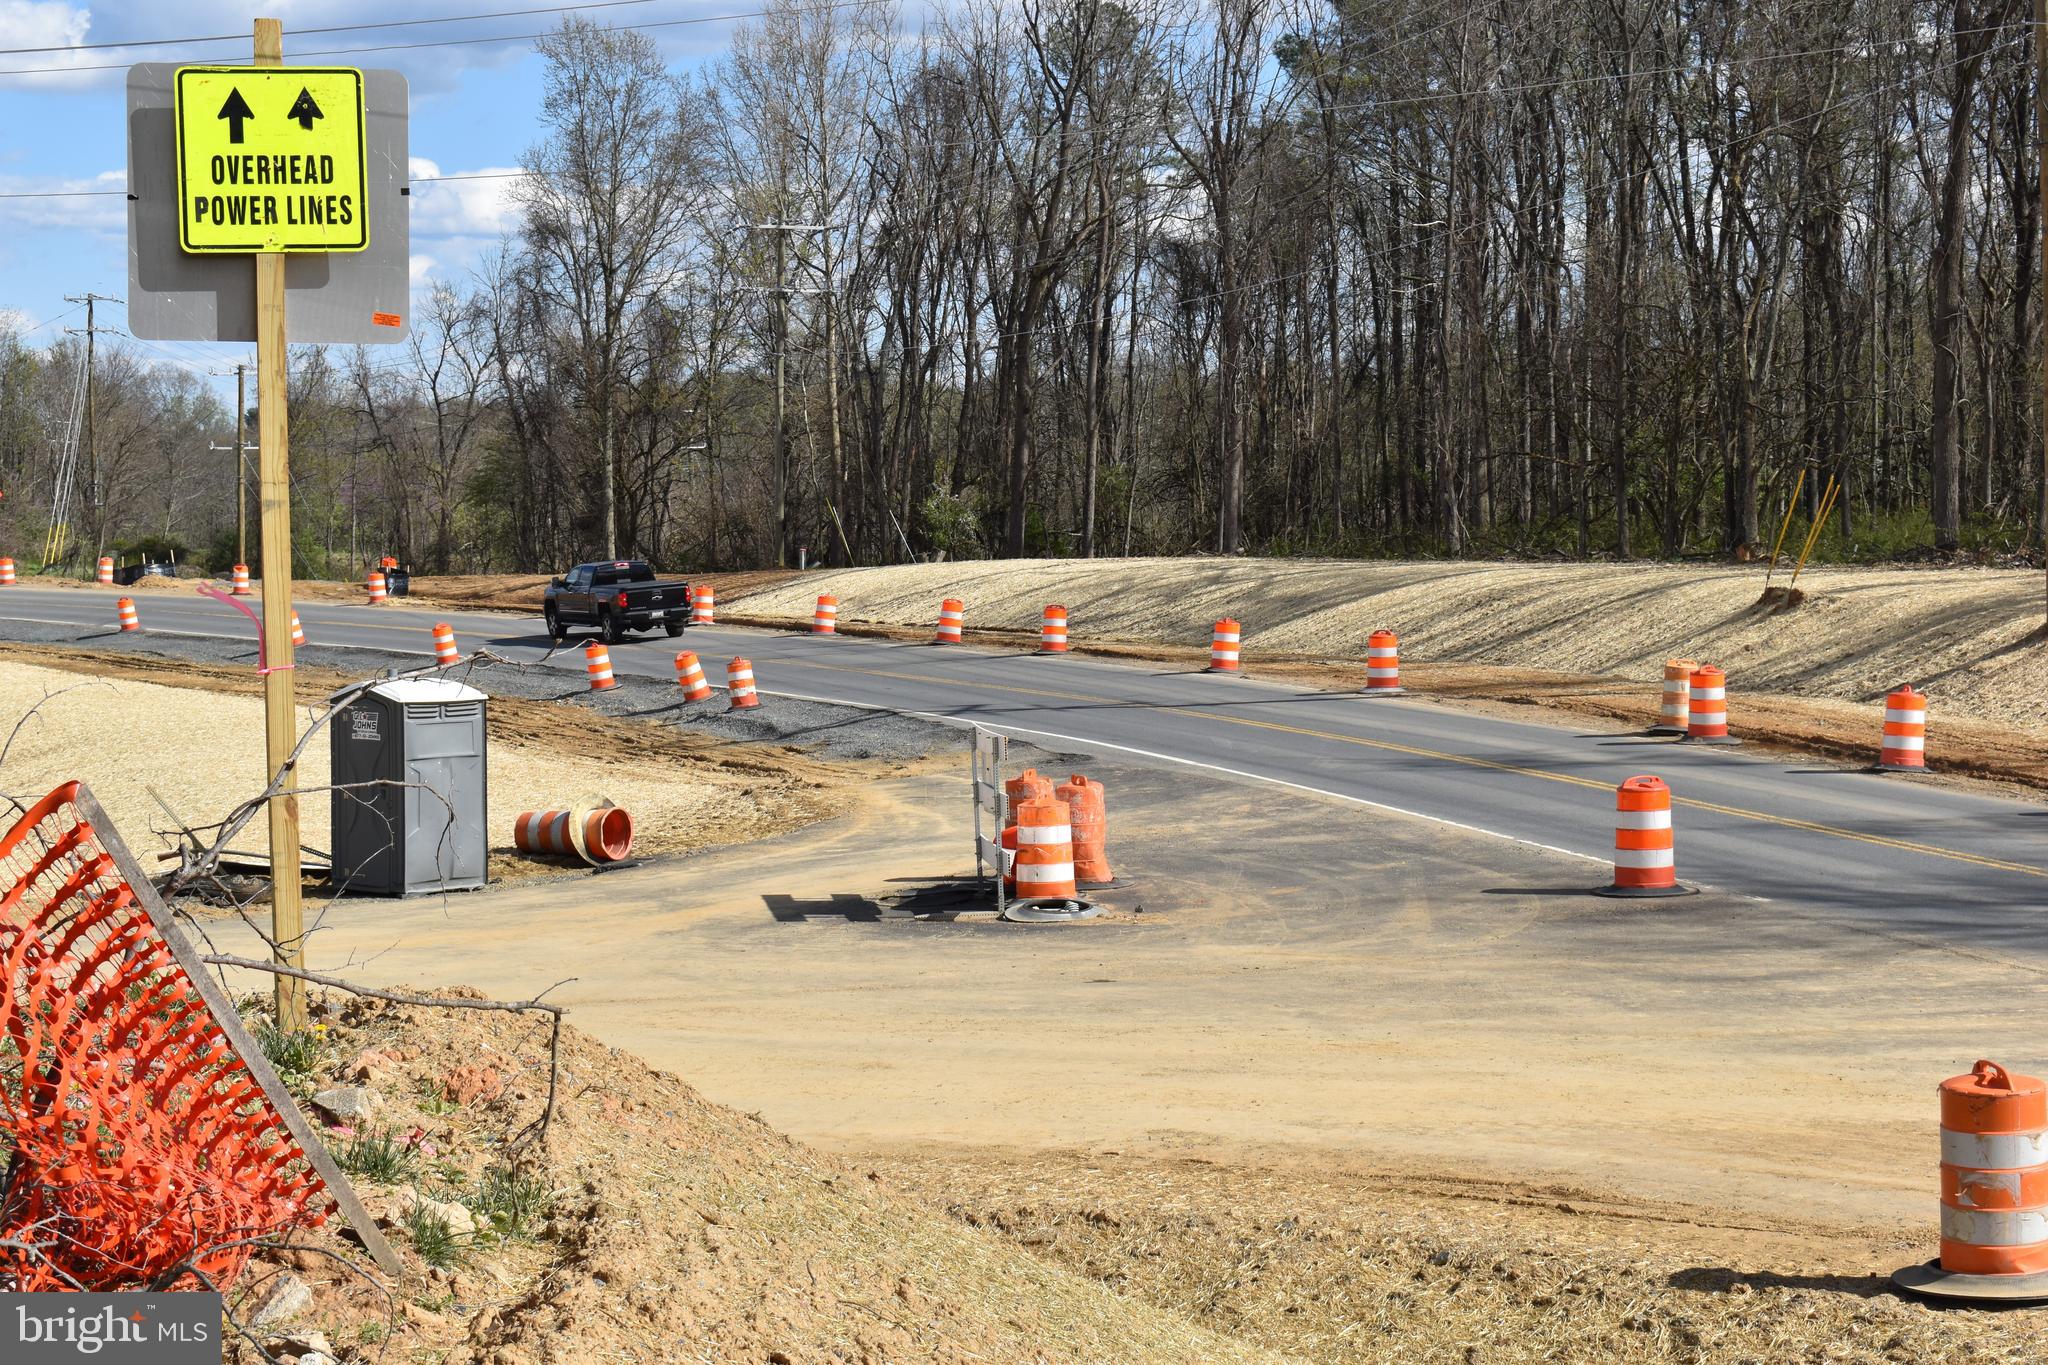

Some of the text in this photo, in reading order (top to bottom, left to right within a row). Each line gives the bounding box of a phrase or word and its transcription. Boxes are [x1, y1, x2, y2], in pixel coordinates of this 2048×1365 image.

[211, 155, 334, 185] OVERHEAD
[194, 195, 352, 225] POWER LINES
[353, 720, 377, 731] JOHNS
